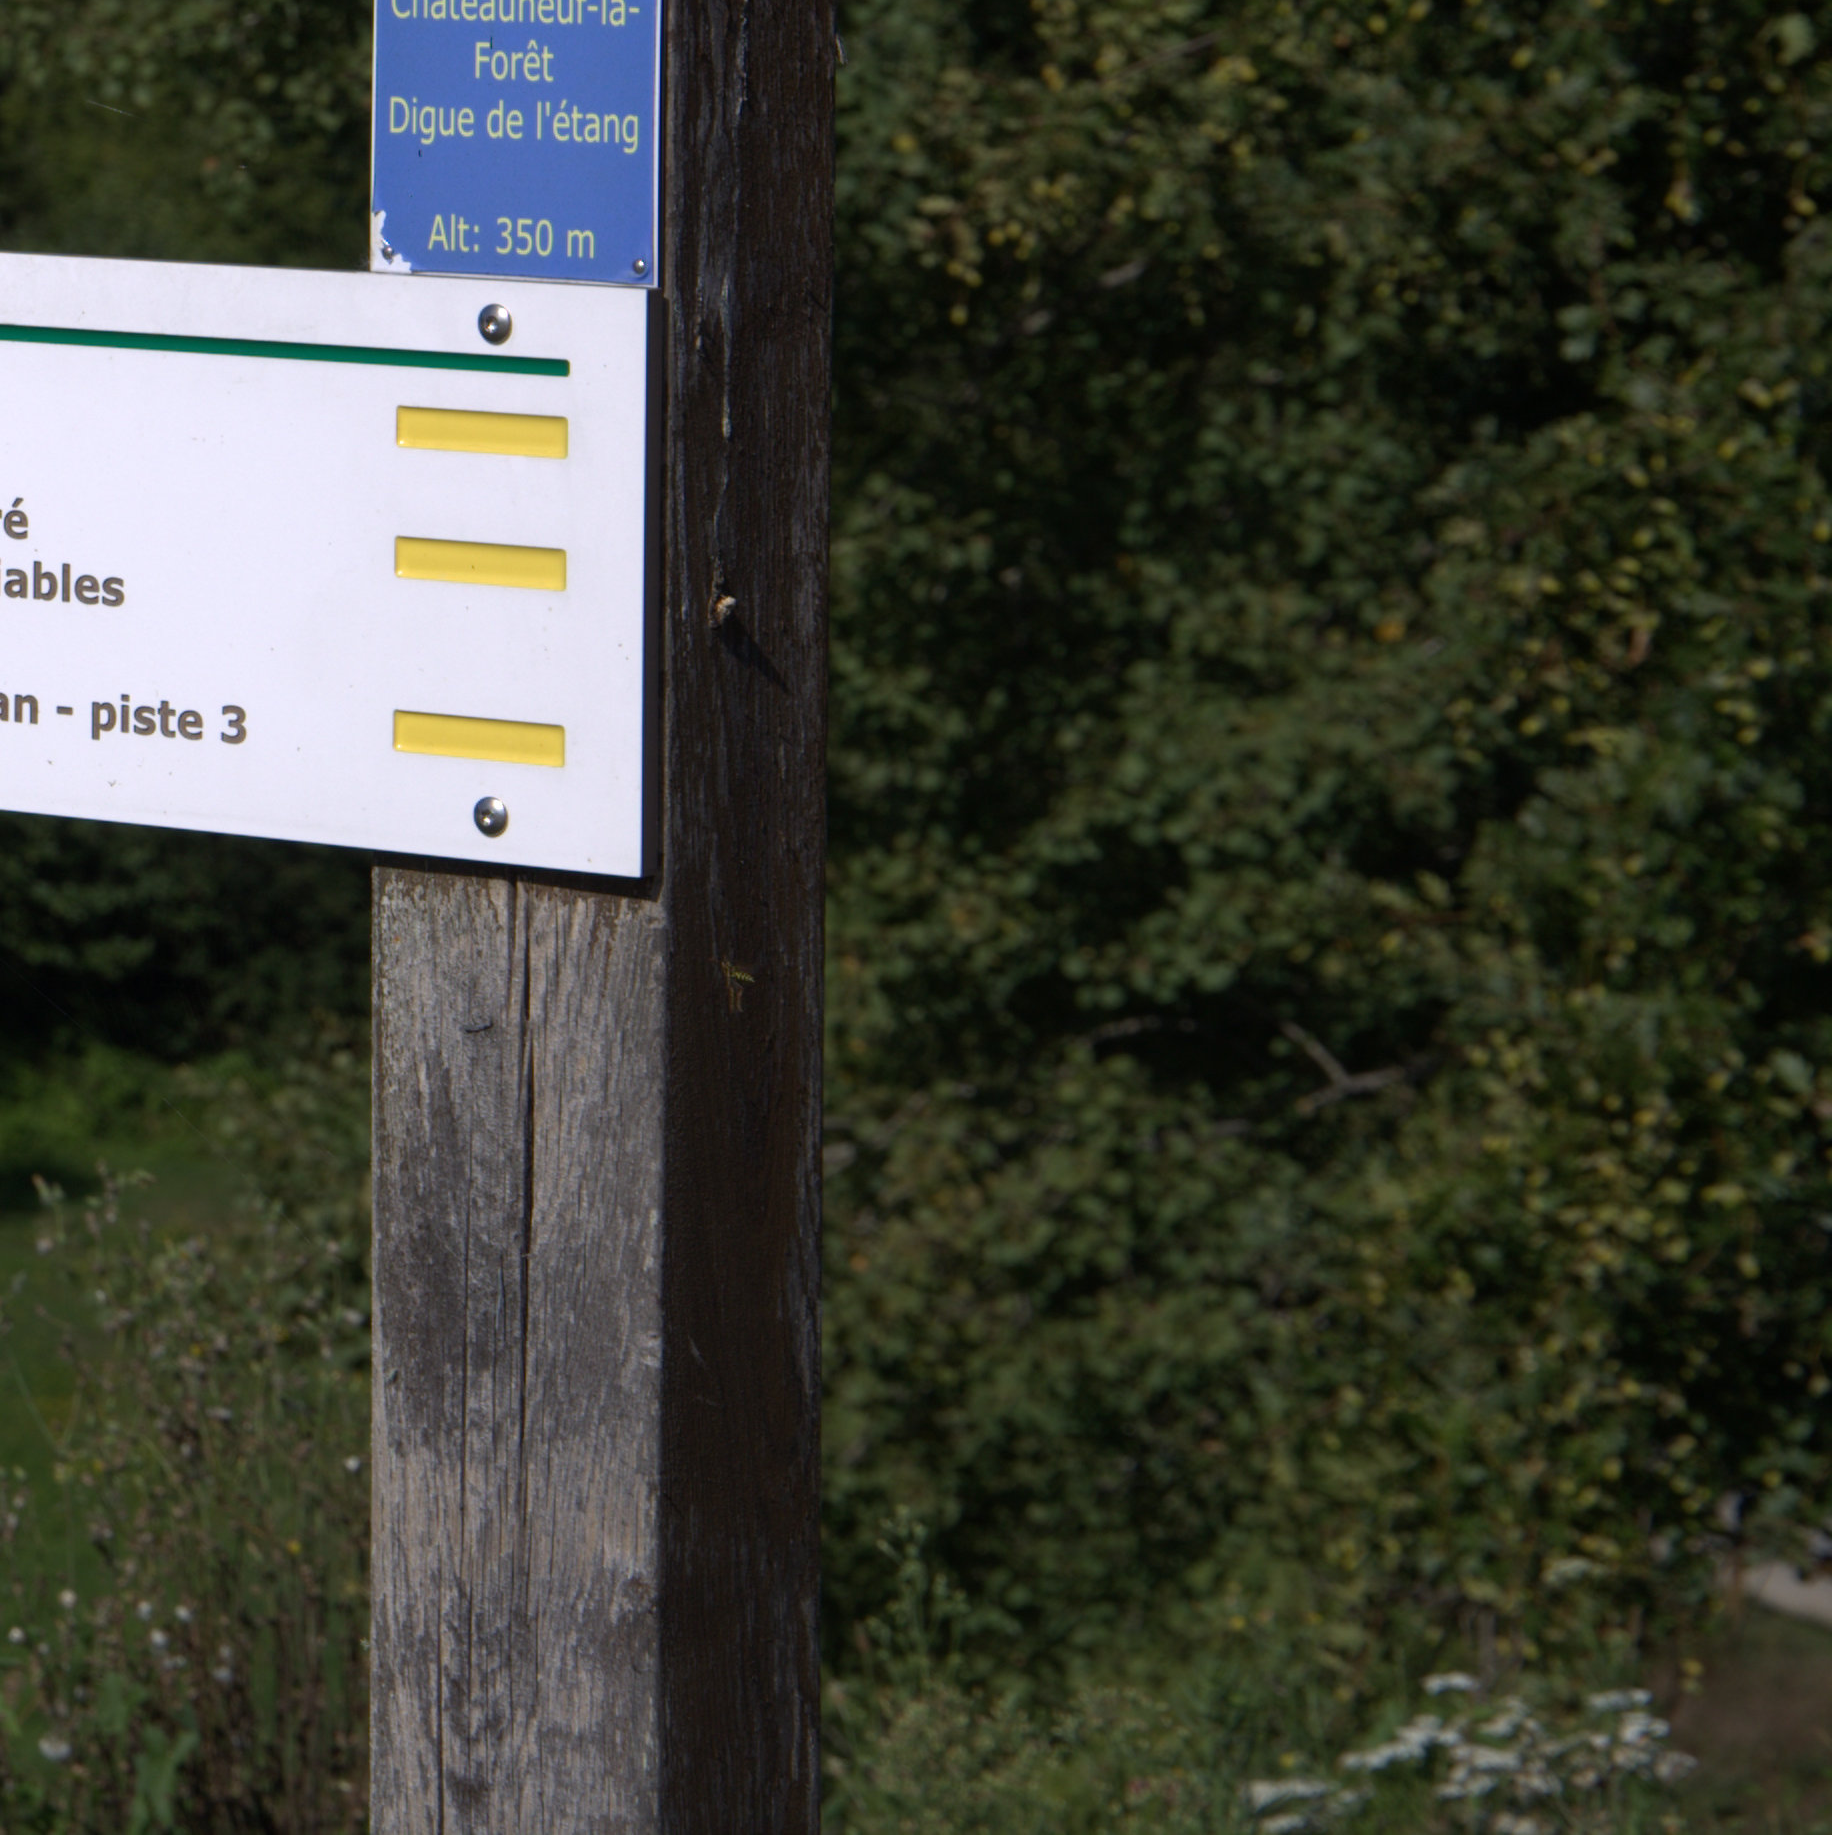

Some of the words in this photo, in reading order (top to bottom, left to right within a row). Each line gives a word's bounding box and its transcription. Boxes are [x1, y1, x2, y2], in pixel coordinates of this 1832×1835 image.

[475, 40, 554, 82] Forêt
[389, 96, 474, 144] Digue
[487, 100, 523, 139] de
[537, 99, 638, 153] l'étang
[428, 215, 480, 252] Alt:
[496, 218, 553, 256] 350
[567, 229, 594, 258] m
[91, 693, 204, 741] piste
[220, 704, 247, 745] 3
